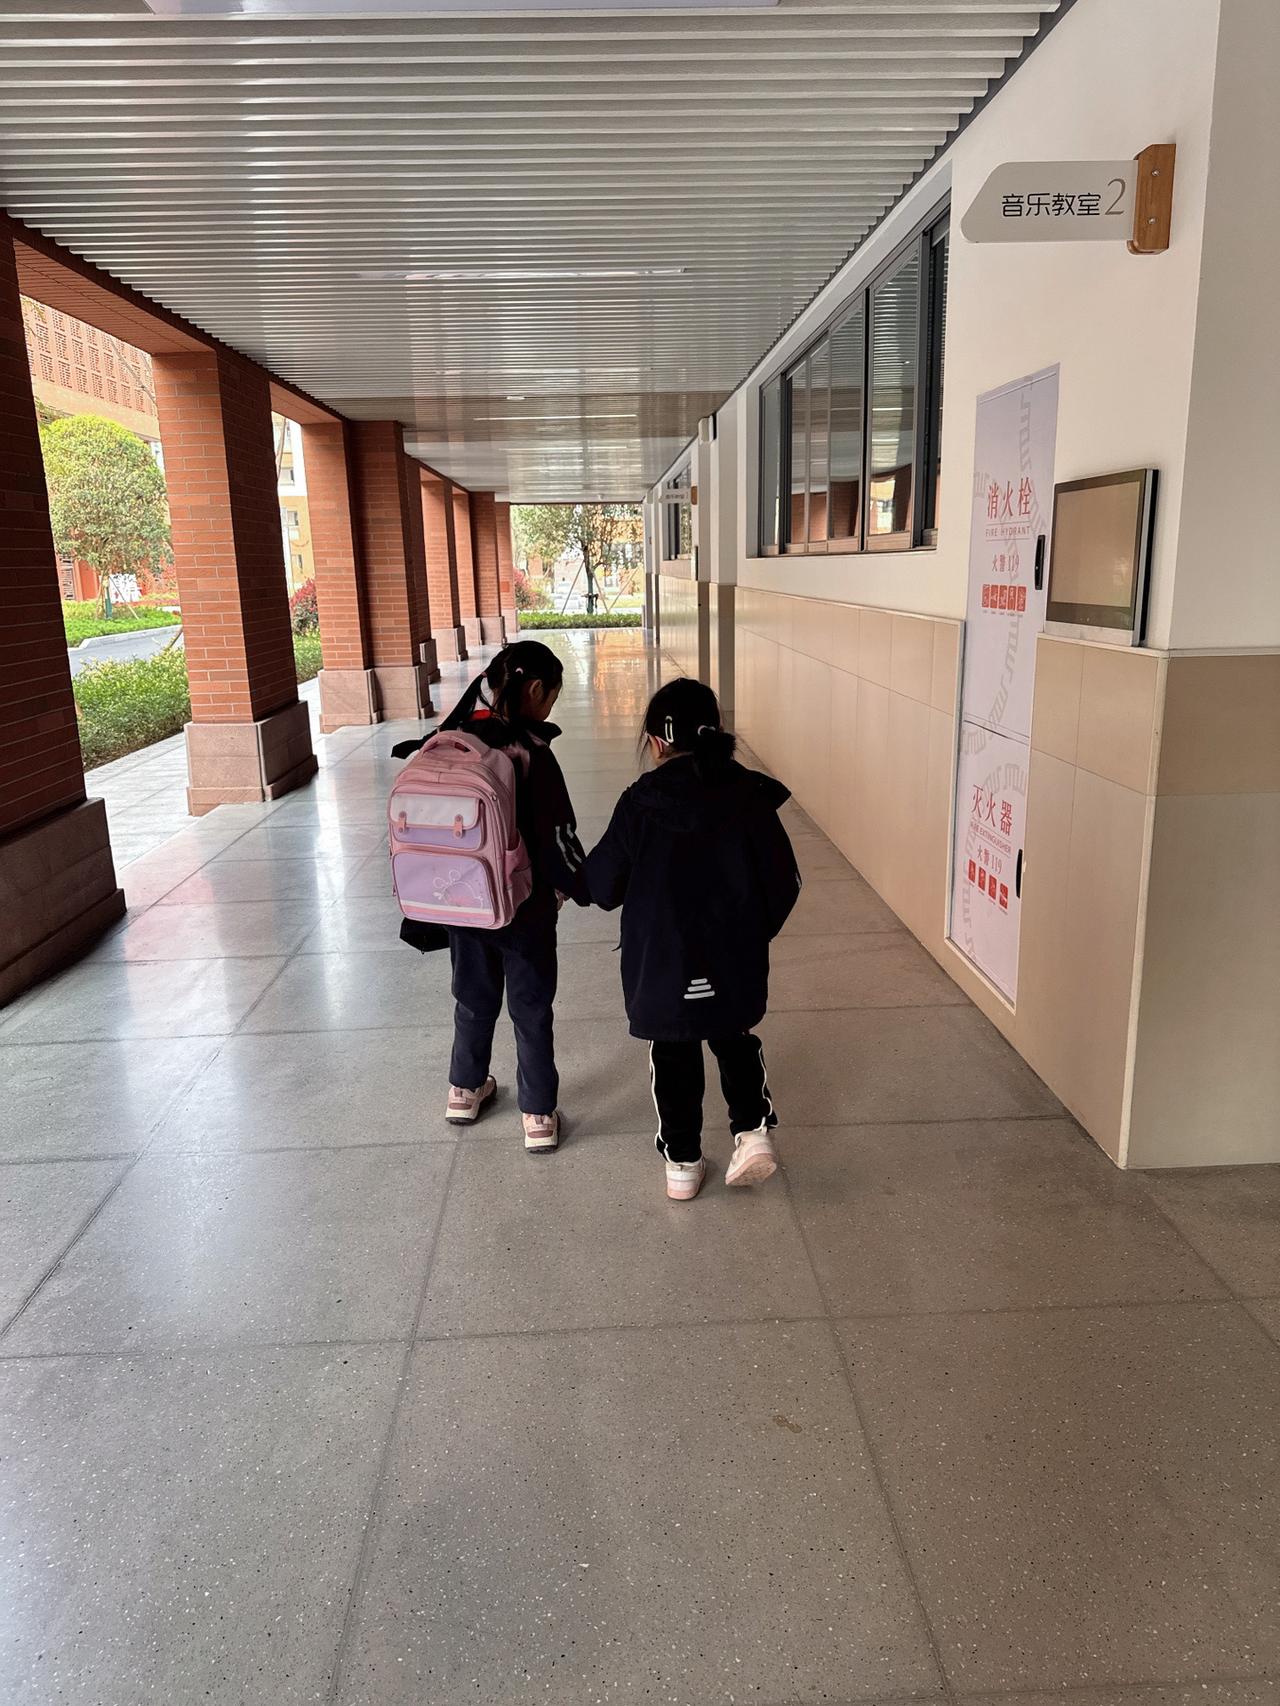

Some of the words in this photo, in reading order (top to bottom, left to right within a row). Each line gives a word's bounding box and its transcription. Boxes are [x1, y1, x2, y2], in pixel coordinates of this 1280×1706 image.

[987, 477, 1032, 519] 消火栓
[985, 528, 998, 537] FIRE
[1000, 526, 1030, 537] HYDRANT
[971, 784, 1012, 836] 灭火器
